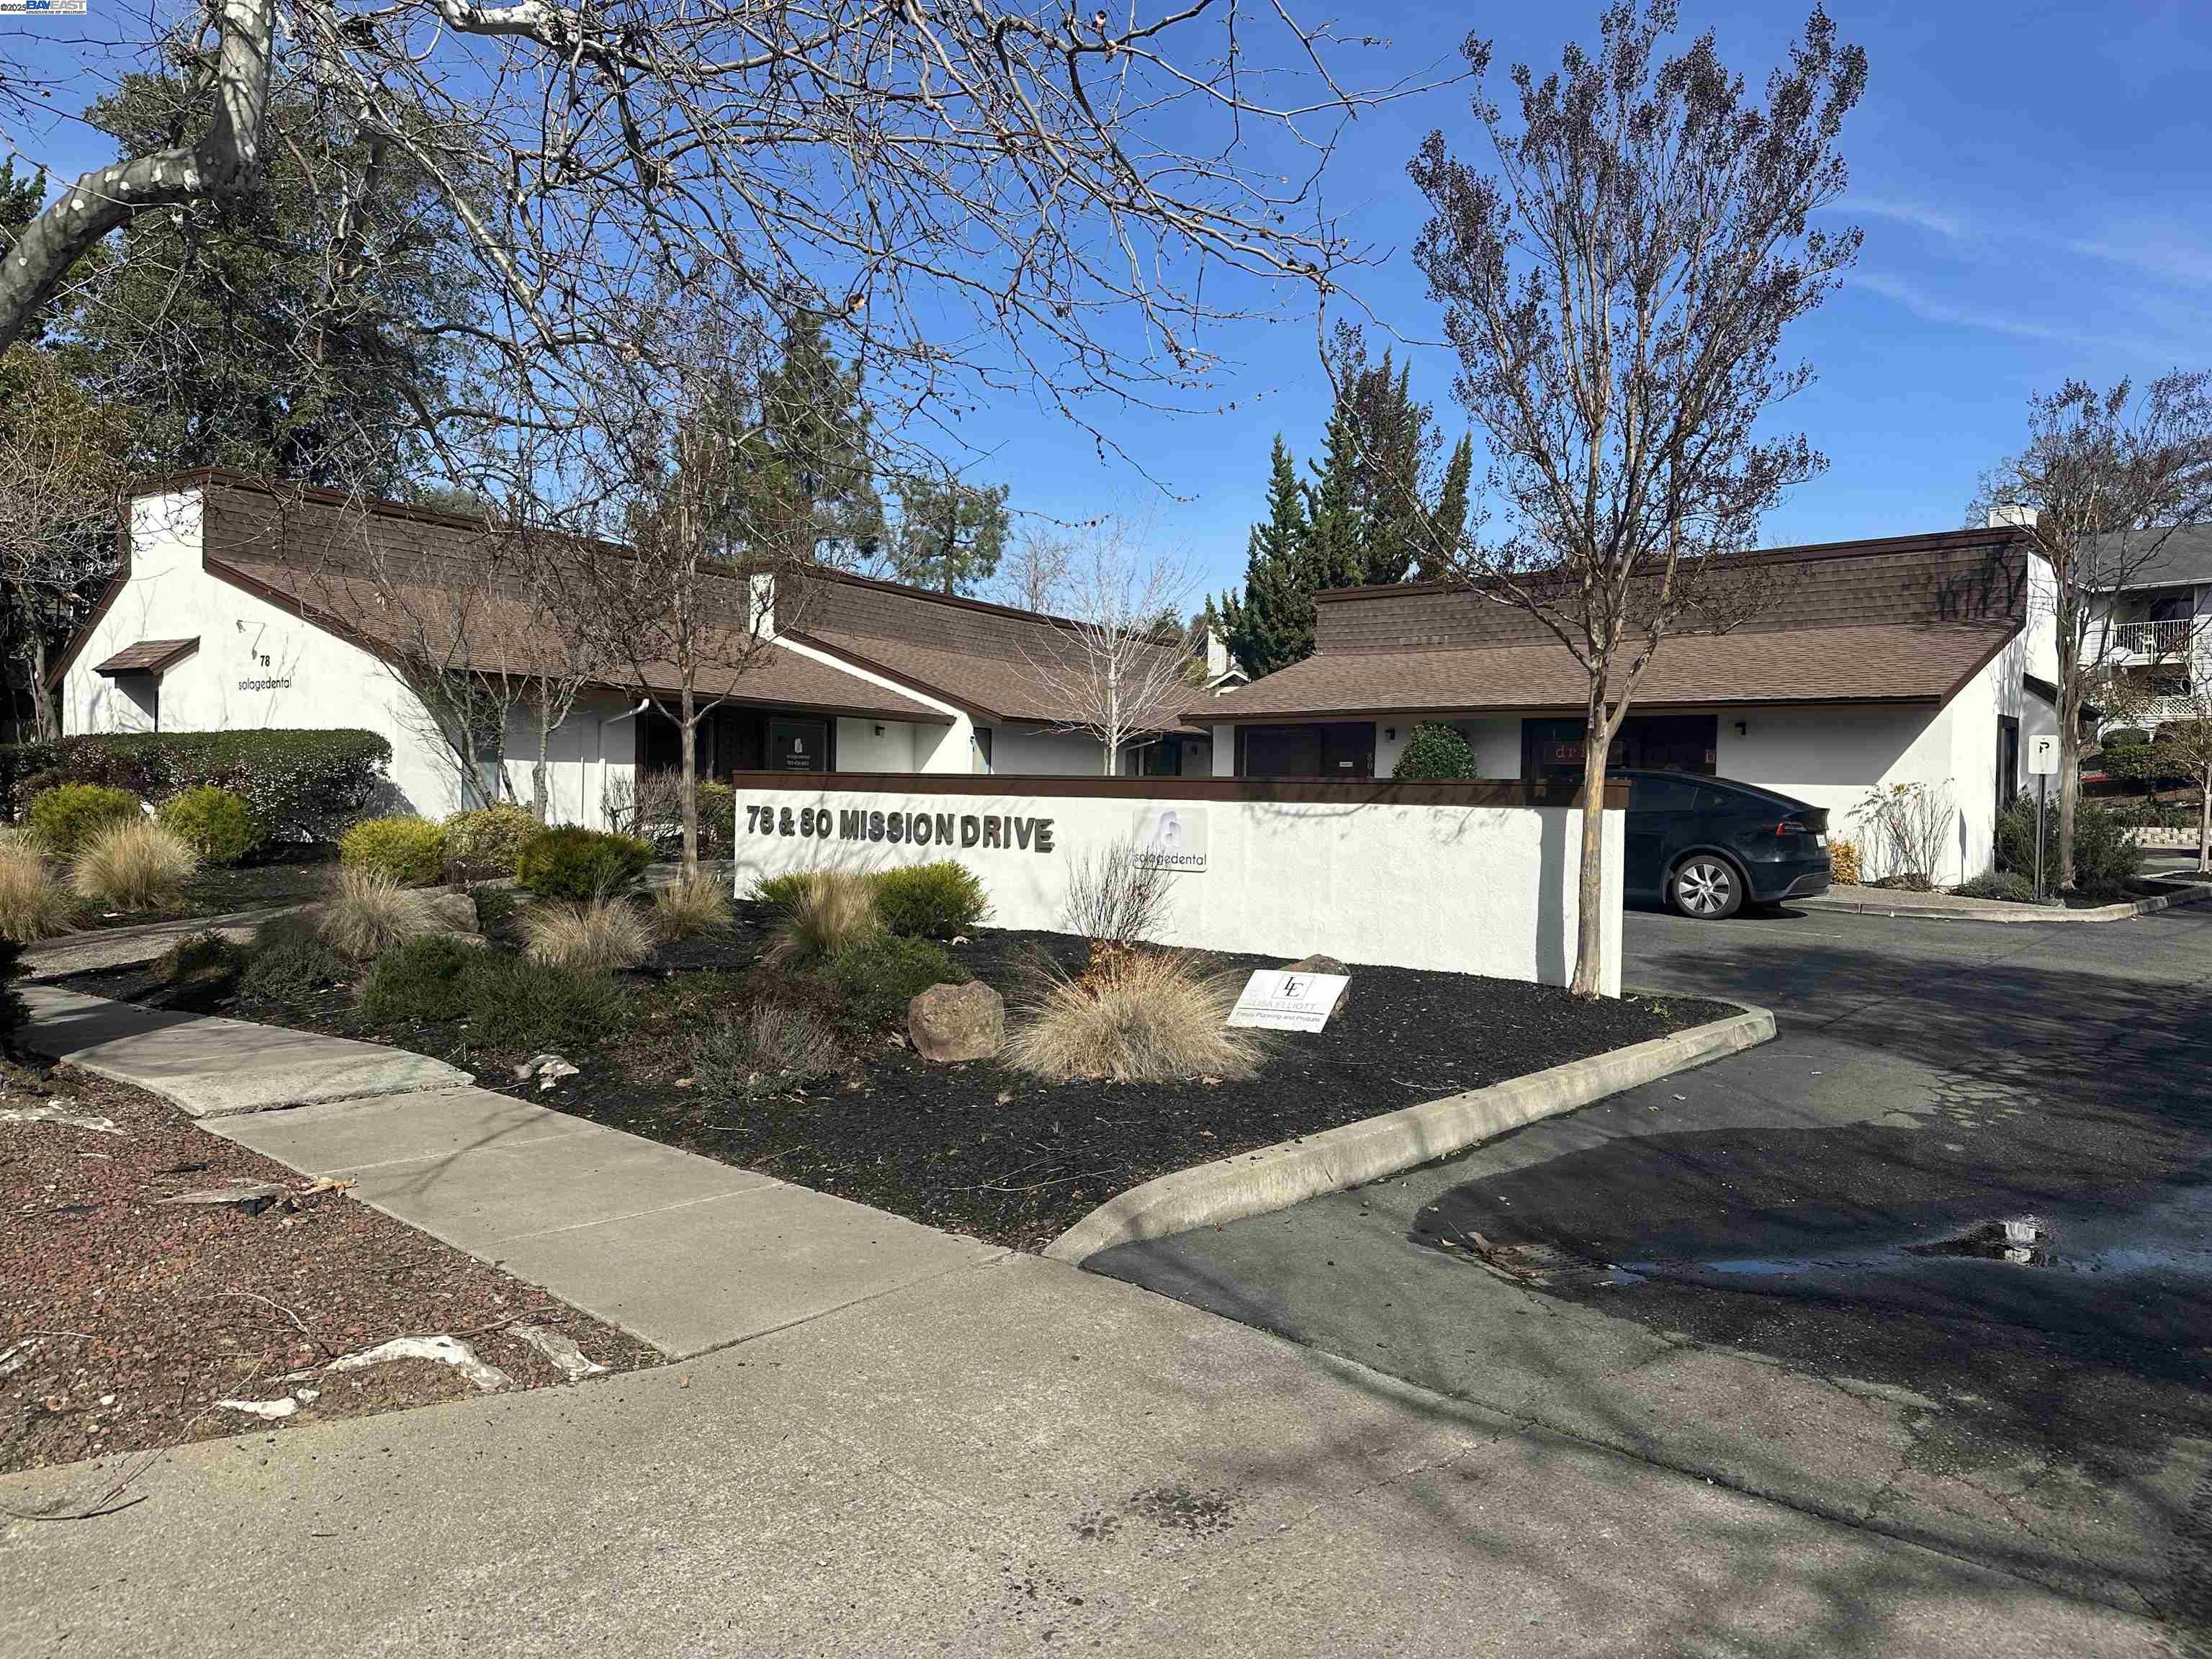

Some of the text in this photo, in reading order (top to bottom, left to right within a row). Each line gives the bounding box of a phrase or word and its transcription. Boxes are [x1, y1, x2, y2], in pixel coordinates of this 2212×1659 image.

[260, 655, 270, 667] 78
[238, 676, 292, 691] solagedental
[747, 805, 1056, 853] 78 & 80 MISSION DRIVE
[1274, 1001, 1317, 1010] ELLIOTT
